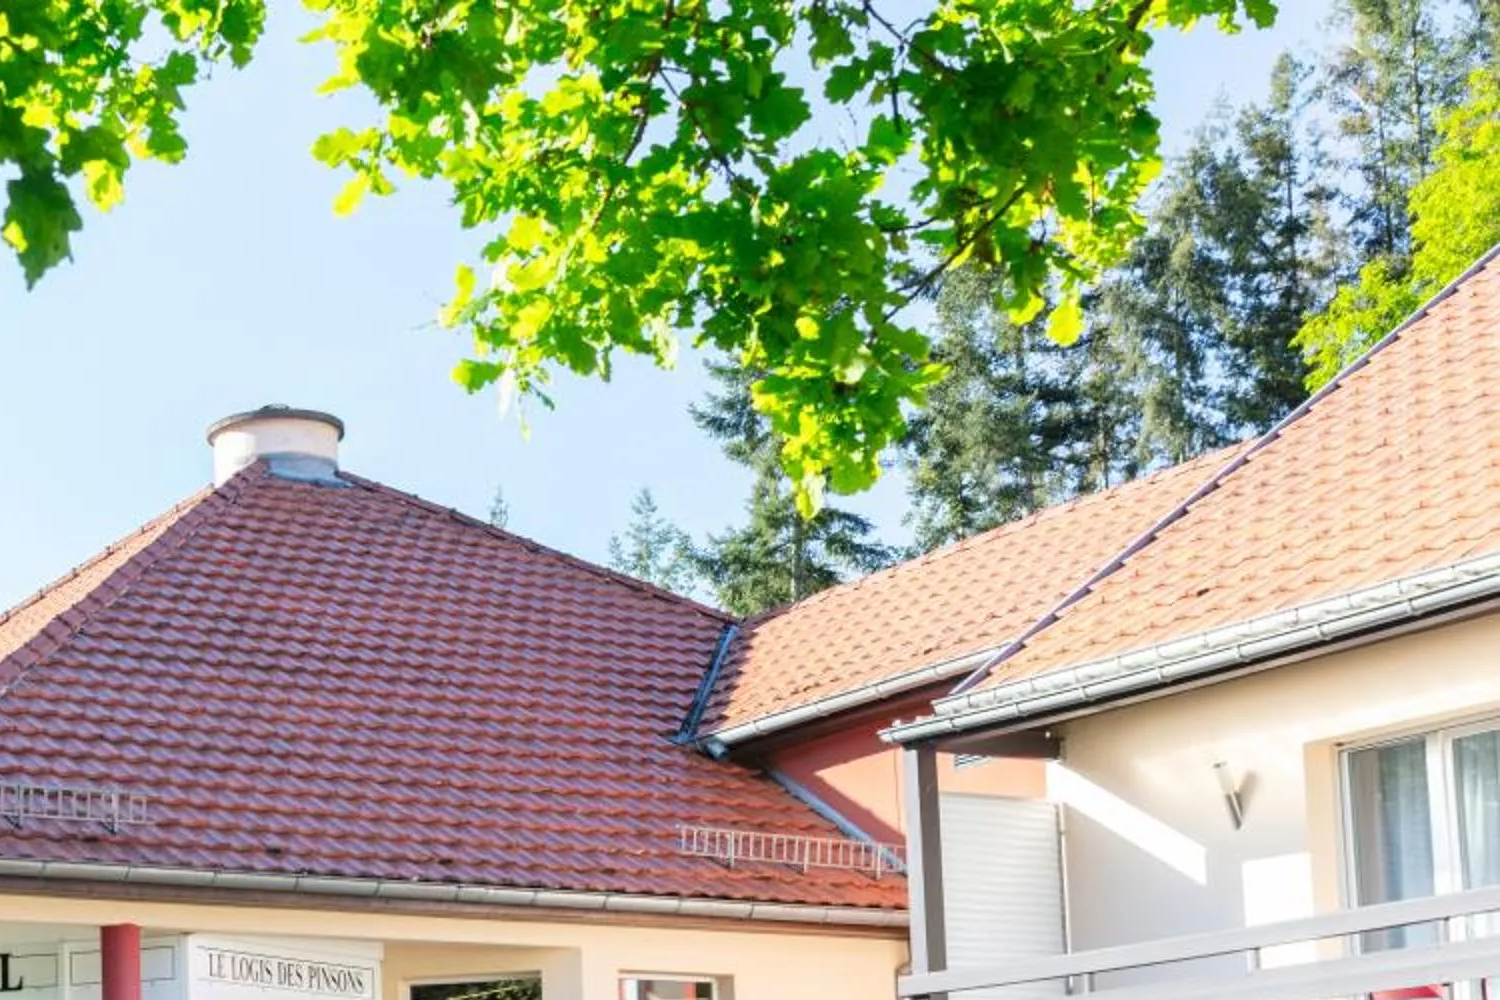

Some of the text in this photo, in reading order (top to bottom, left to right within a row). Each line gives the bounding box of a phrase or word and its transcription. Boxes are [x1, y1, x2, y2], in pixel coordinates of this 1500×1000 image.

[208, 953, 365, 994] LE LOGIS DES PINSONS
